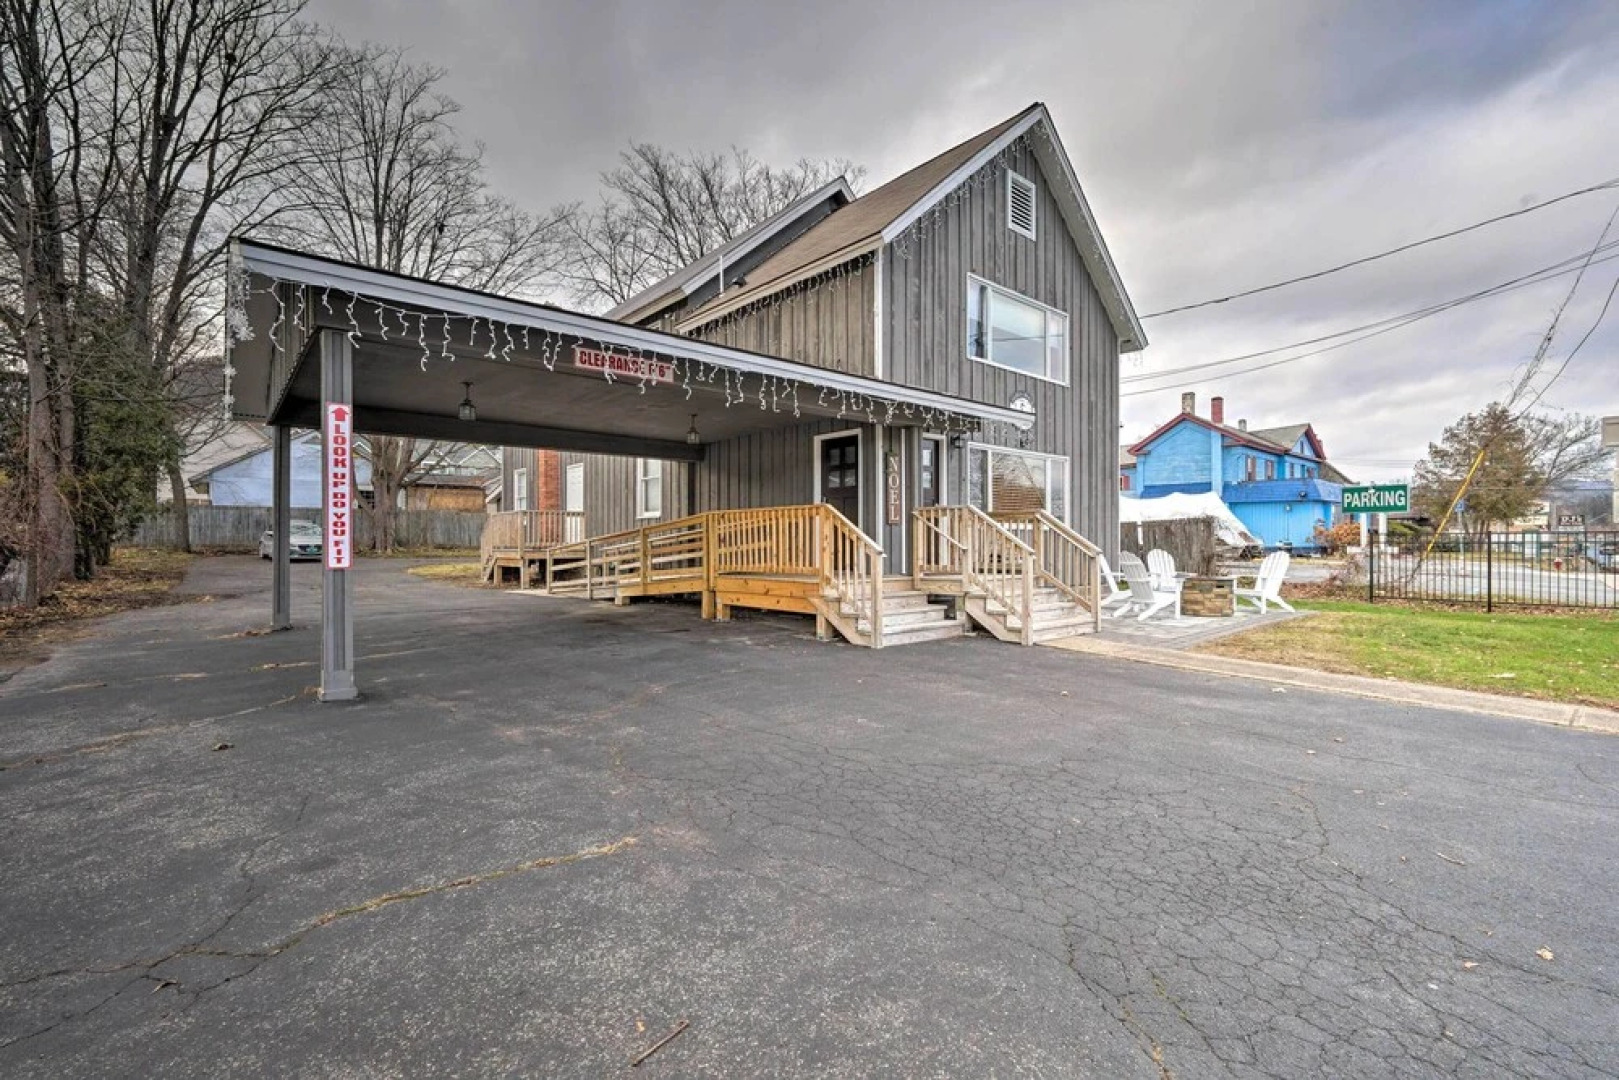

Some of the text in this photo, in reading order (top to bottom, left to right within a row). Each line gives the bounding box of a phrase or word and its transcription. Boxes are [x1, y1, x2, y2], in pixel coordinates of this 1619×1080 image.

[332, 424, 347, 564] LOOK UP DO YOU FIT
[888, 456, 900, 521] NOEL
[1343, 489, 1406, 508] PARKING
